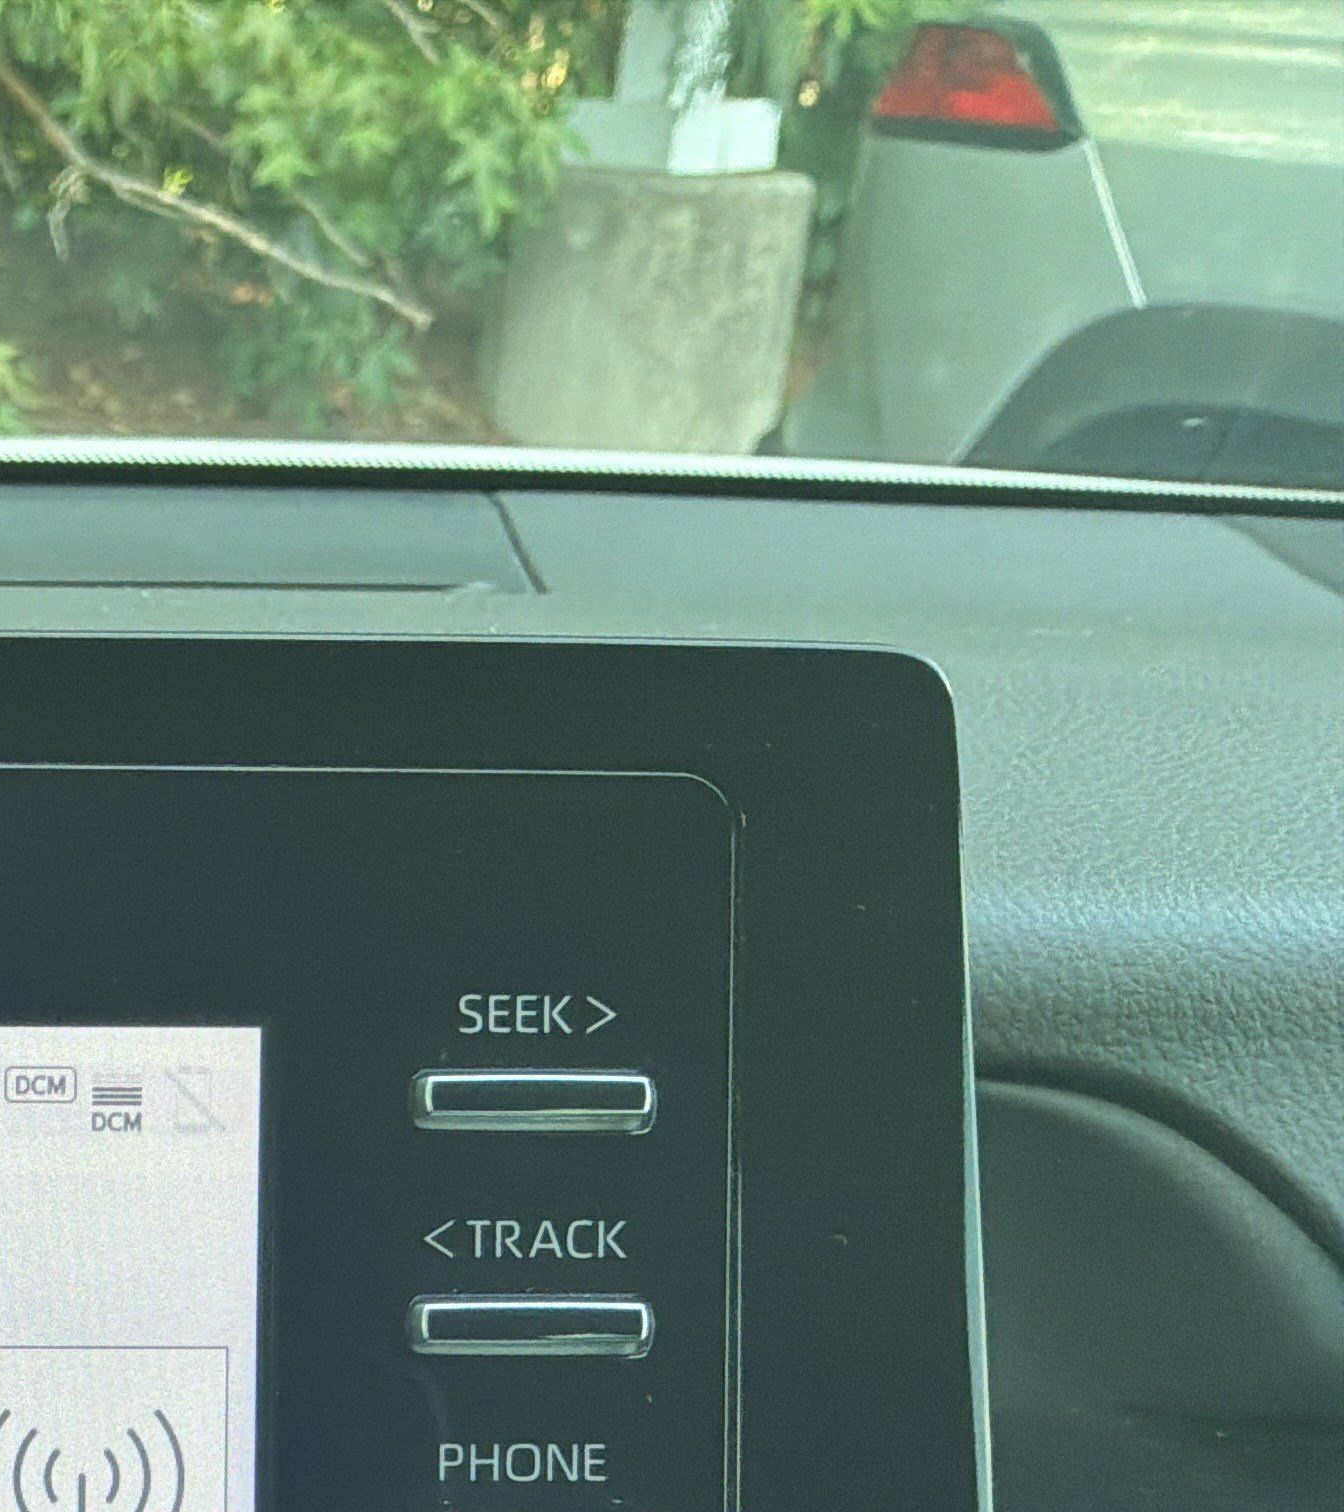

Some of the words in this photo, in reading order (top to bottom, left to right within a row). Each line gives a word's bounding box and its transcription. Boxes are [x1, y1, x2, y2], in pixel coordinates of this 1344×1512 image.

[15, 1074, 67, 1096] DCM
[91, 1112, 143, 1132] DCM
[439, 1443, 606, 1481] PHONE
